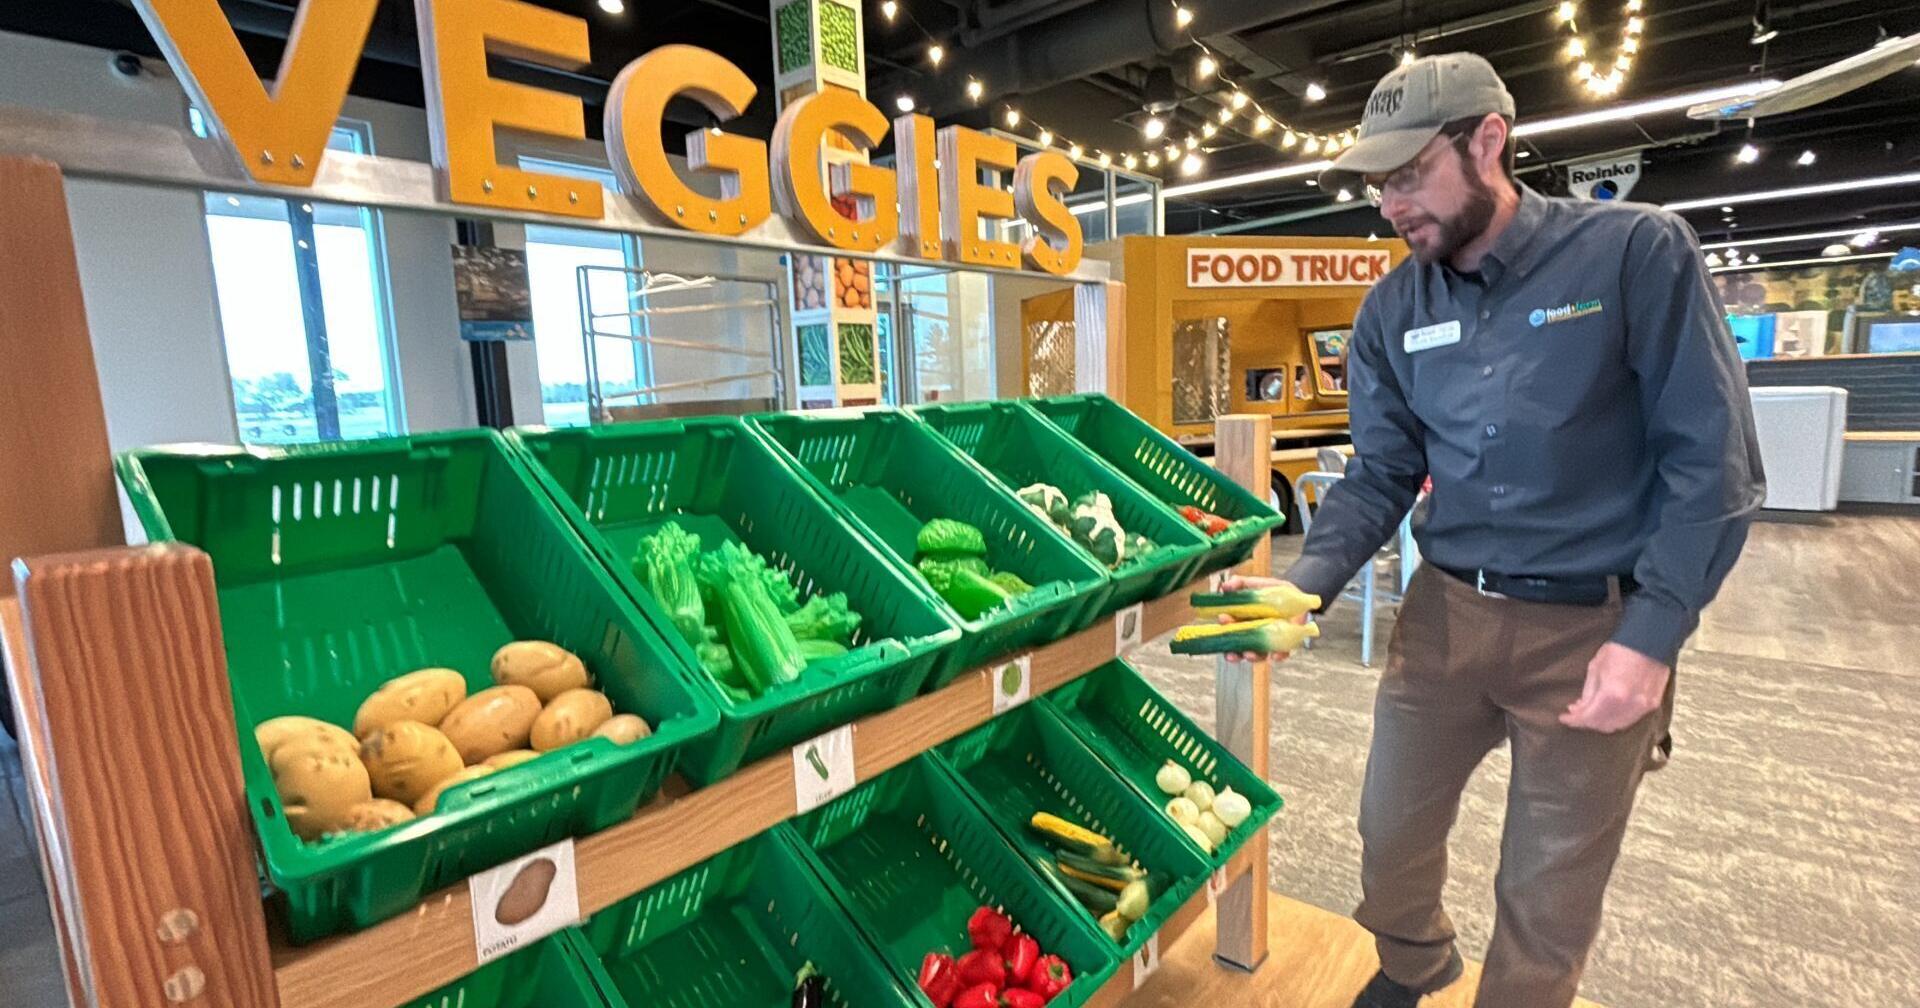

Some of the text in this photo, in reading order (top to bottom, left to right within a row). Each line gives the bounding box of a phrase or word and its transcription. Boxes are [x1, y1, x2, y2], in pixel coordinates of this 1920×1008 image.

[132, 0, 1083, 275] VEGGIES
[1572, 163, 1636, 184] Reinke
[1191, 254, 1388, 283] FOOD TRUCK
